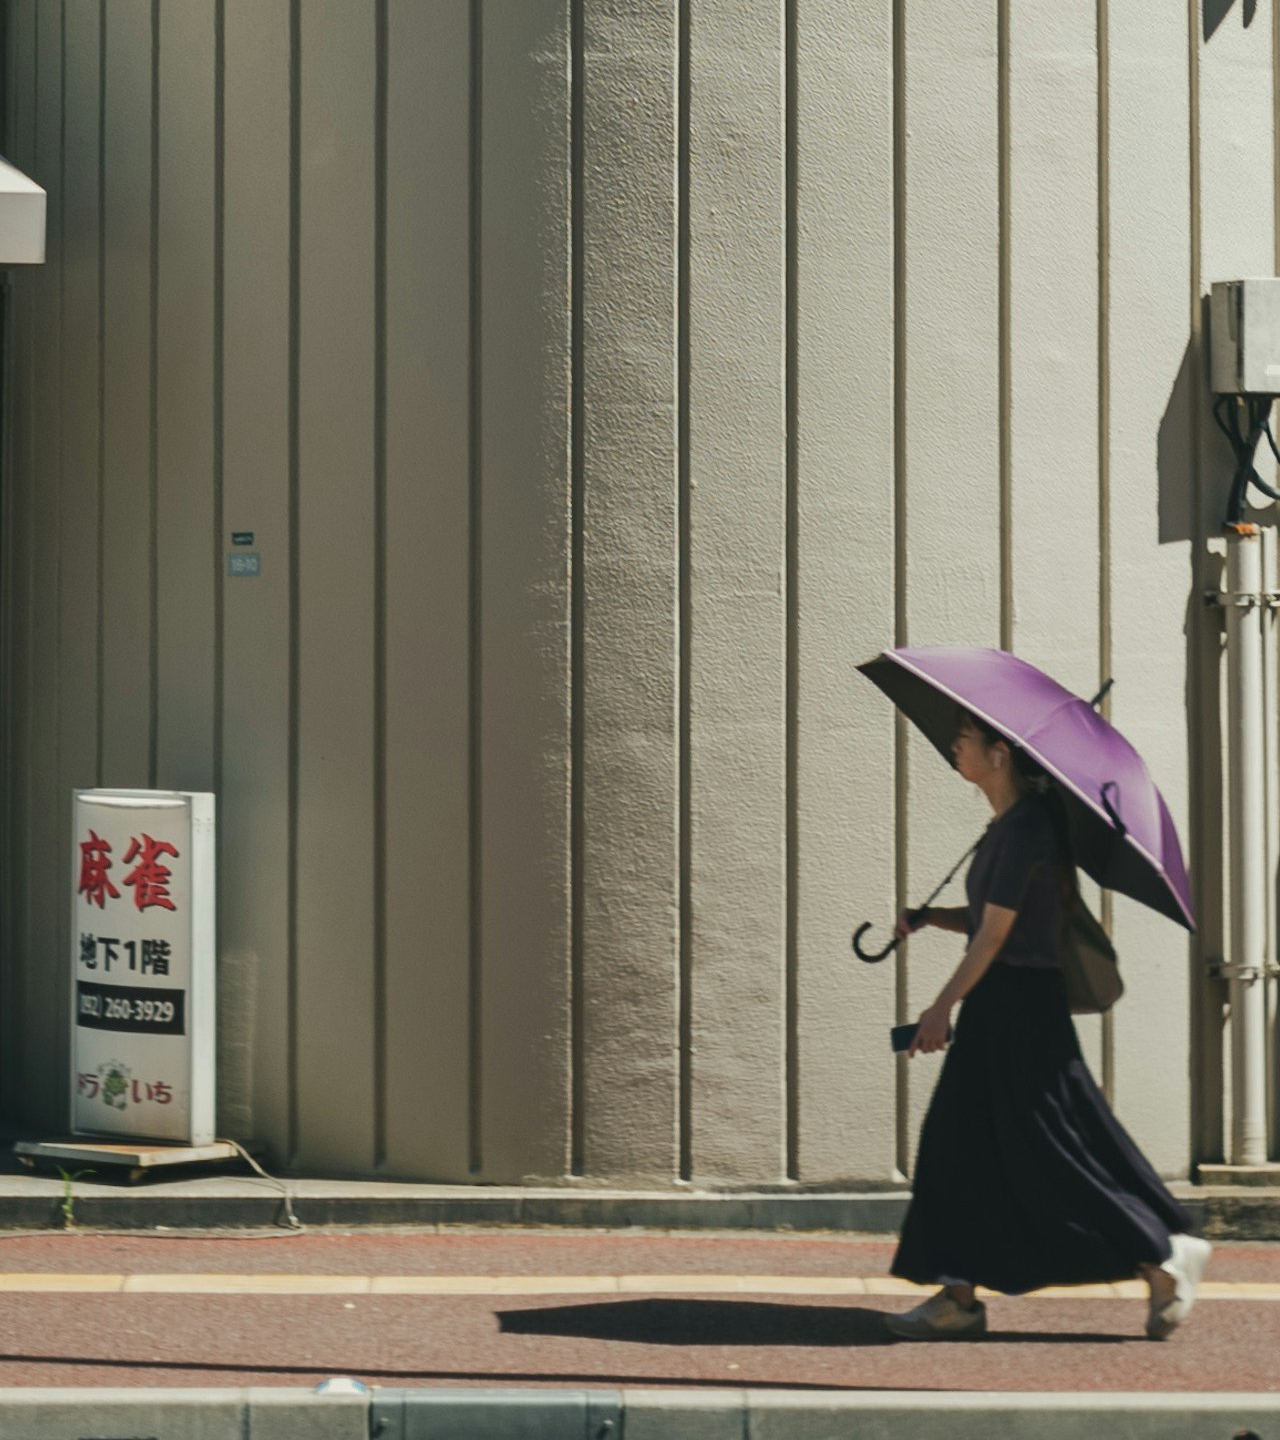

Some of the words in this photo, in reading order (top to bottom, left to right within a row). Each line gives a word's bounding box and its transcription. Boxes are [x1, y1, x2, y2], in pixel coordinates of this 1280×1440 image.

[78, 828, 180, 913] 麻雀
[80, 933, 171, 976] 地下1階
[105, 997, 175, 1023] 260-3929
[131, 1078, 173, 1105] いち
